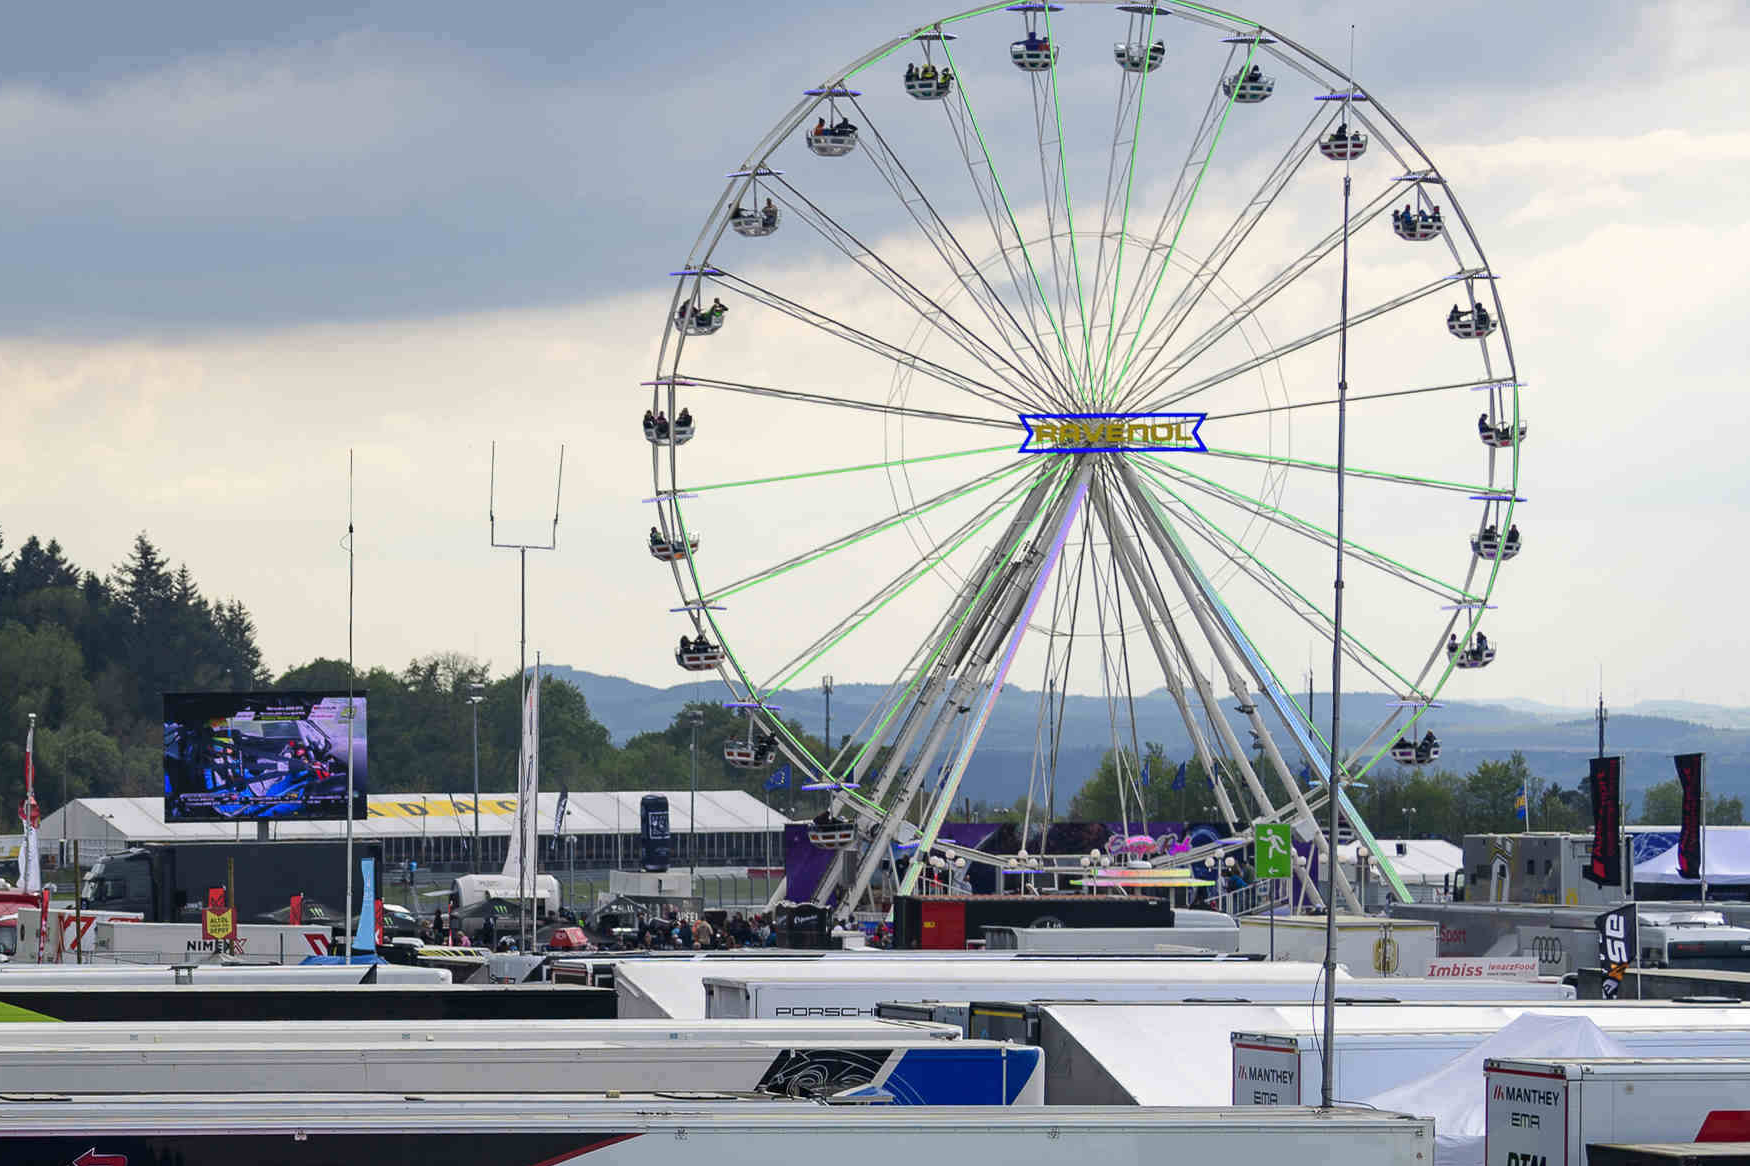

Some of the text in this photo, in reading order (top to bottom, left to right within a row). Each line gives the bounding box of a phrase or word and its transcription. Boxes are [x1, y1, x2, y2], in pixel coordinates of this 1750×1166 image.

[1036, 423, 1193, 442] RAVENOL
[1428, 962, 1483, 978] Imbiss
[776, 1008, 874, 1017] PORSCH
[1249, 1068, 1294, 1085] MANTHEY
[1505, 1086, 1560, 1107] MANTHEY
